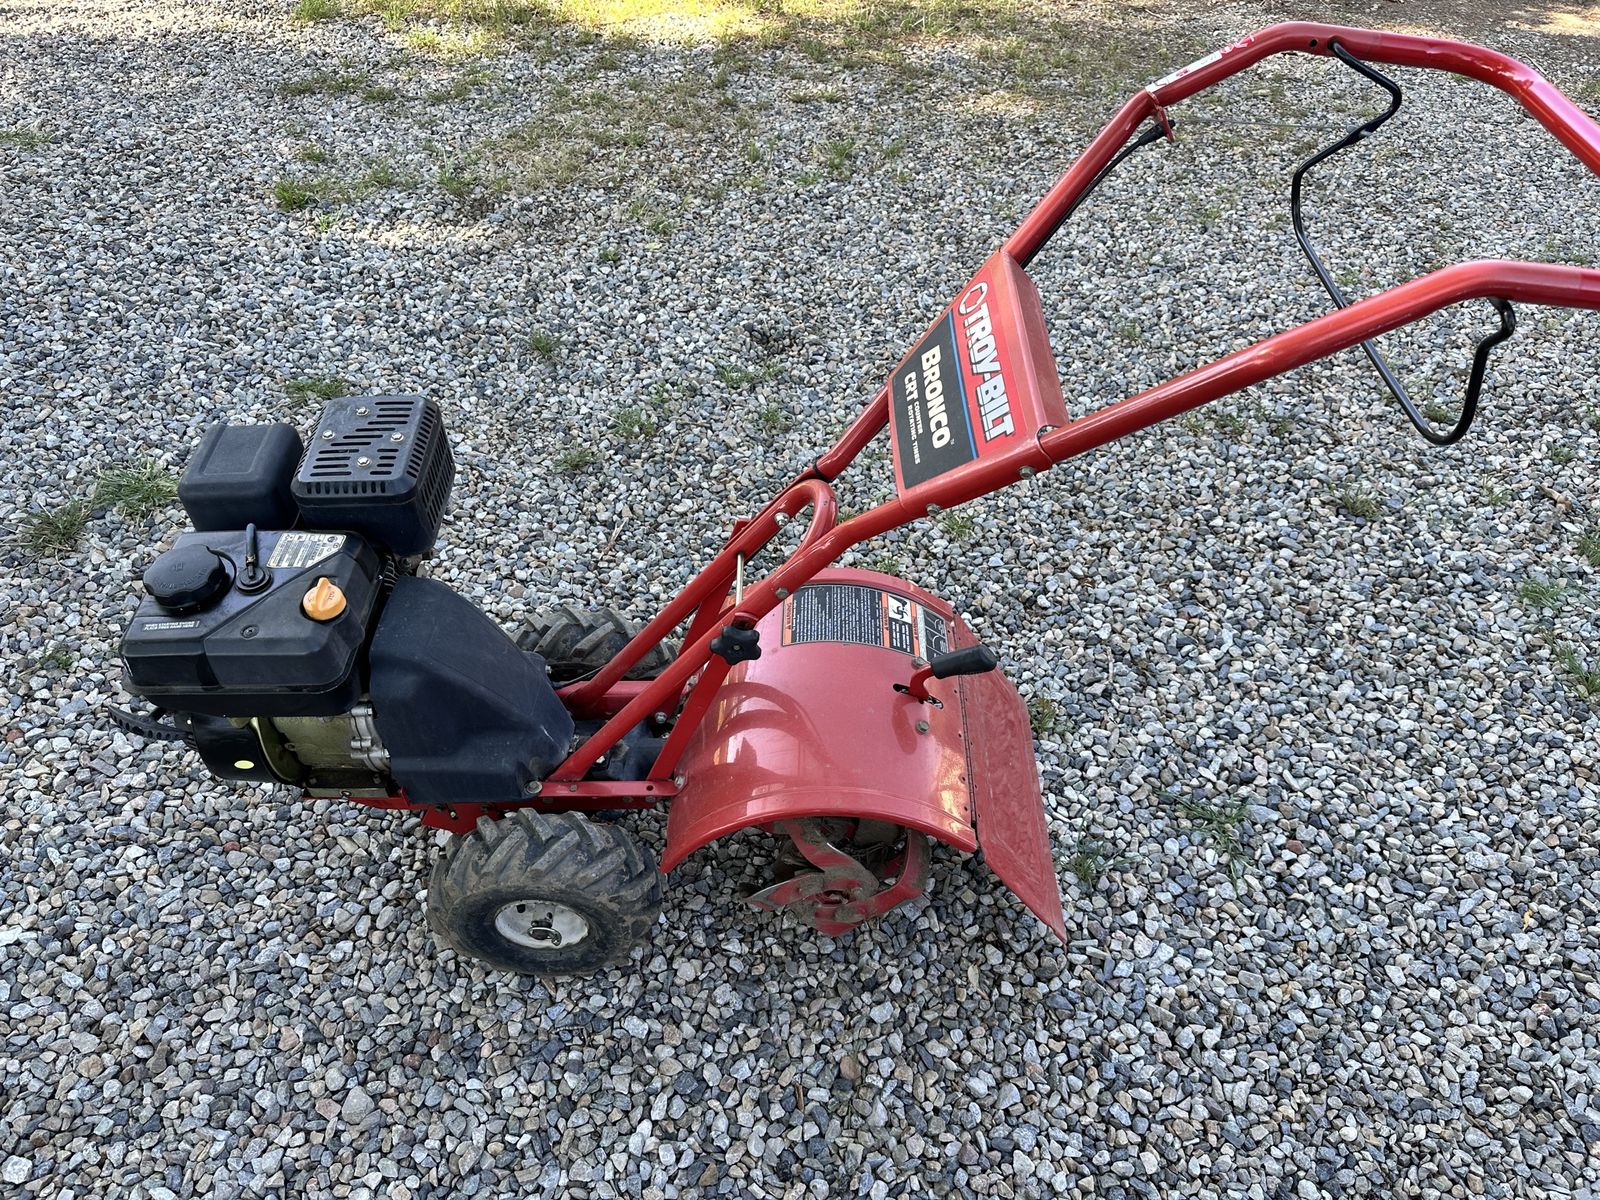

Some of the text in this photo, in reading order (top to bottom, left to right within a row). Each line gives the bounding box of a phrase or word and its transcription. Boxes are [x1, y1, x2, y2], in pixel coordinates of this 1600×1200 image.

[904, 371, 919, 402] CRT
[963, 301, 1015, 442] TROY-BILT
[921, 344, 951, 449] BRONCO
[907, 404, 917, 441] ROTATING
[913, 400, 923, 435] COUNTER
[911, 440, 921, 465] TINES
